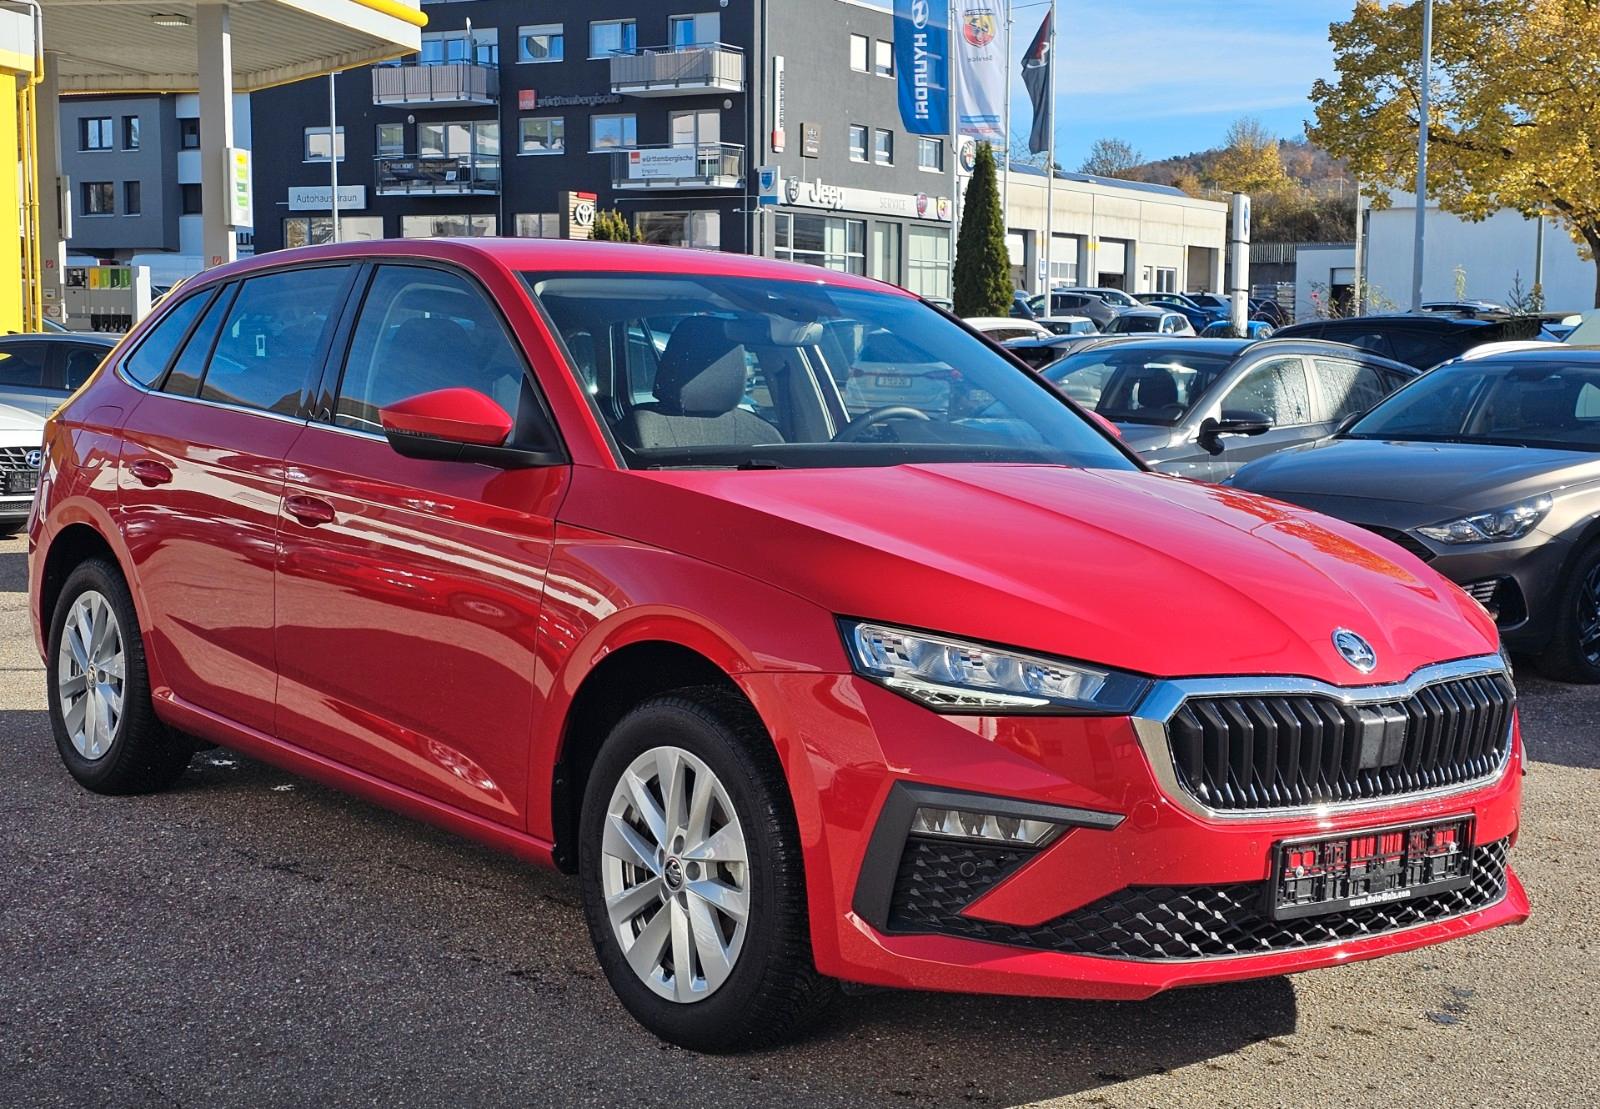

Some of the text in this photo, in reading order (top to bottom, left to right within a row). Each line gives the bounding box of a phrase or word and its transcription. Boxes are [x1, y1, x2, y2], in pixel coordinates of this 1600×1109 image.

[337, 194, 357, 202] raun
[809, 178, 845, 210] Jeep
[879, 197, 906, 210] SERVICE
